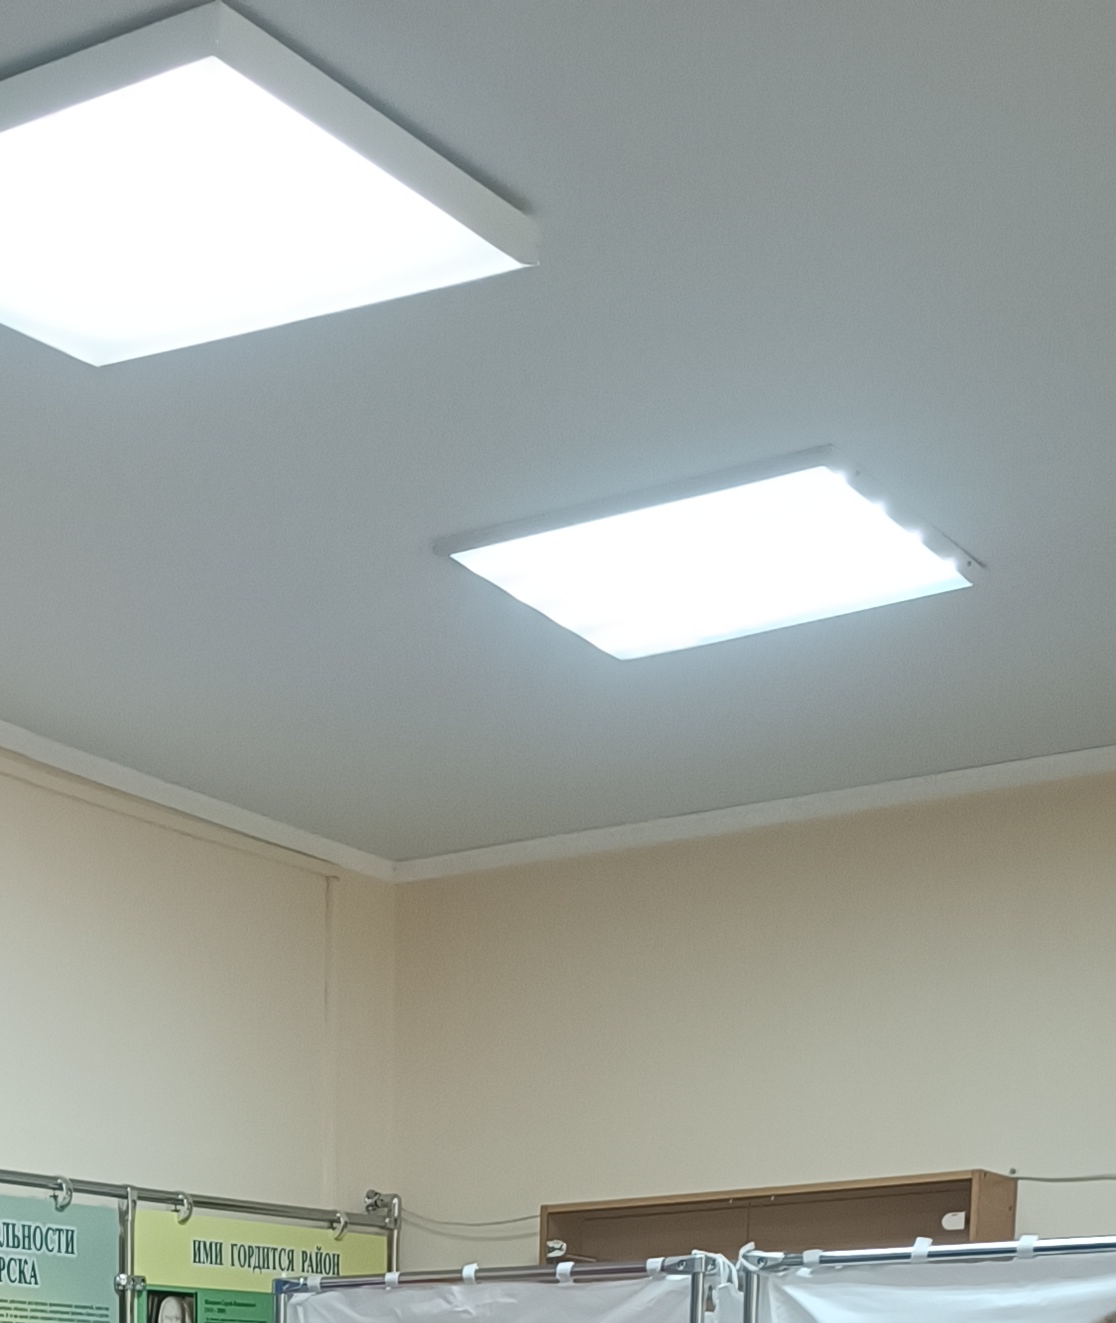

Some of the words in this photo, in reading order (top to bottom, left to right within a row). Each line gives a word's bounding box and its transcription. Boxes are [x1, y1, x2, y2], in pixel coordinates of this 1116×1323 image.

[192, 1239, 223, 1266] ИМИ
[230, 1243, 295, 1275] ГОРДИТСЯ
[301, 1246, 341, 1276] РАЙОН
